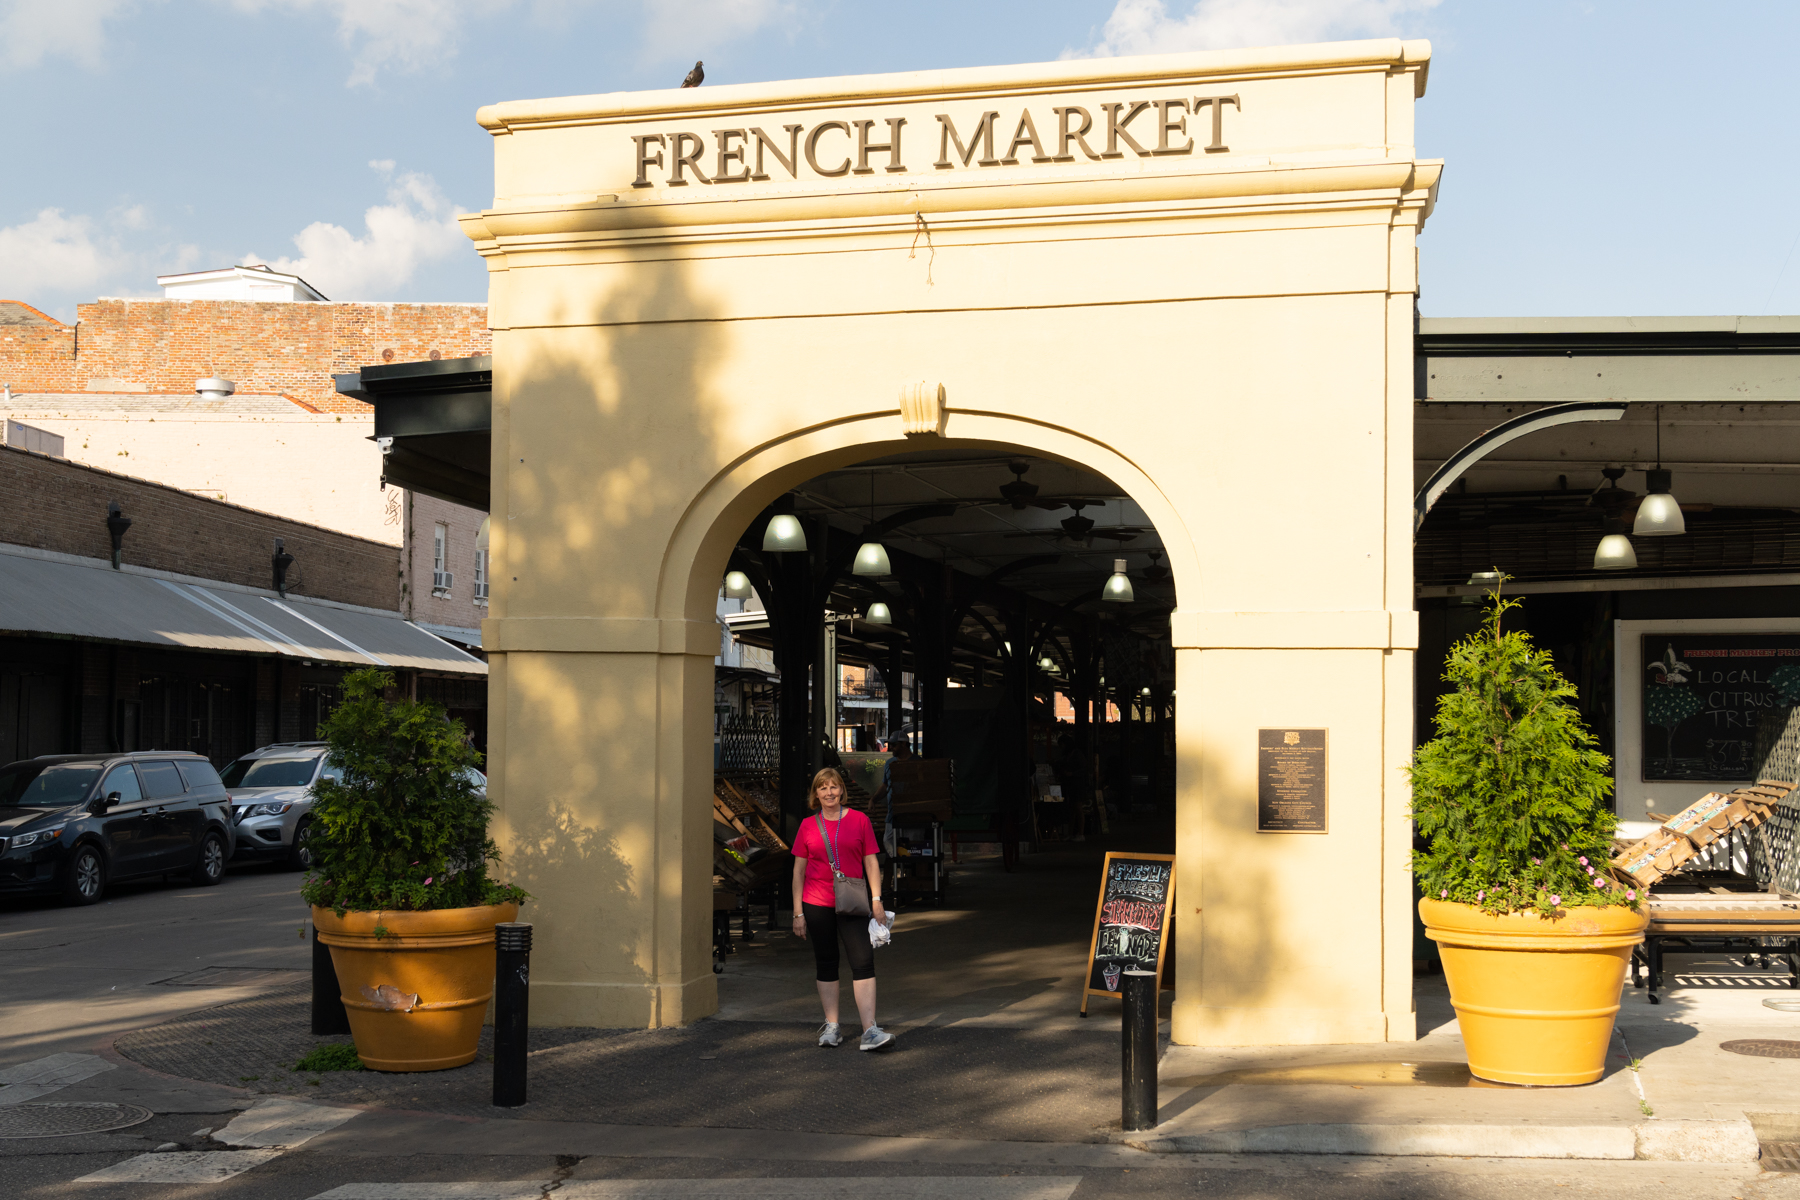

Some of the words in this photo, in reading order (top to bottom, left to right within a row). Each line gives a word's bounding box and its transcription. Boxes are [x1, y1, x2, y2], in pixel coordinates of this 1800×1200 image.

[631, 116, 907, 188] FRENCH
[932, 93, 1241, 169] MARKET
[1684, 649, 1728, 657] FRENCH
[1729, 649, 1776, 657] MARKET
[1698, 669, 1765, 684] LOCAL
[1708, 691, 1774, 708] CITRUS
[1705, 709, 1760, 728] TRE
[1114, 862, 1162, 882] FRESH
[1108, 880, 1164, 894] SQUEEZED
